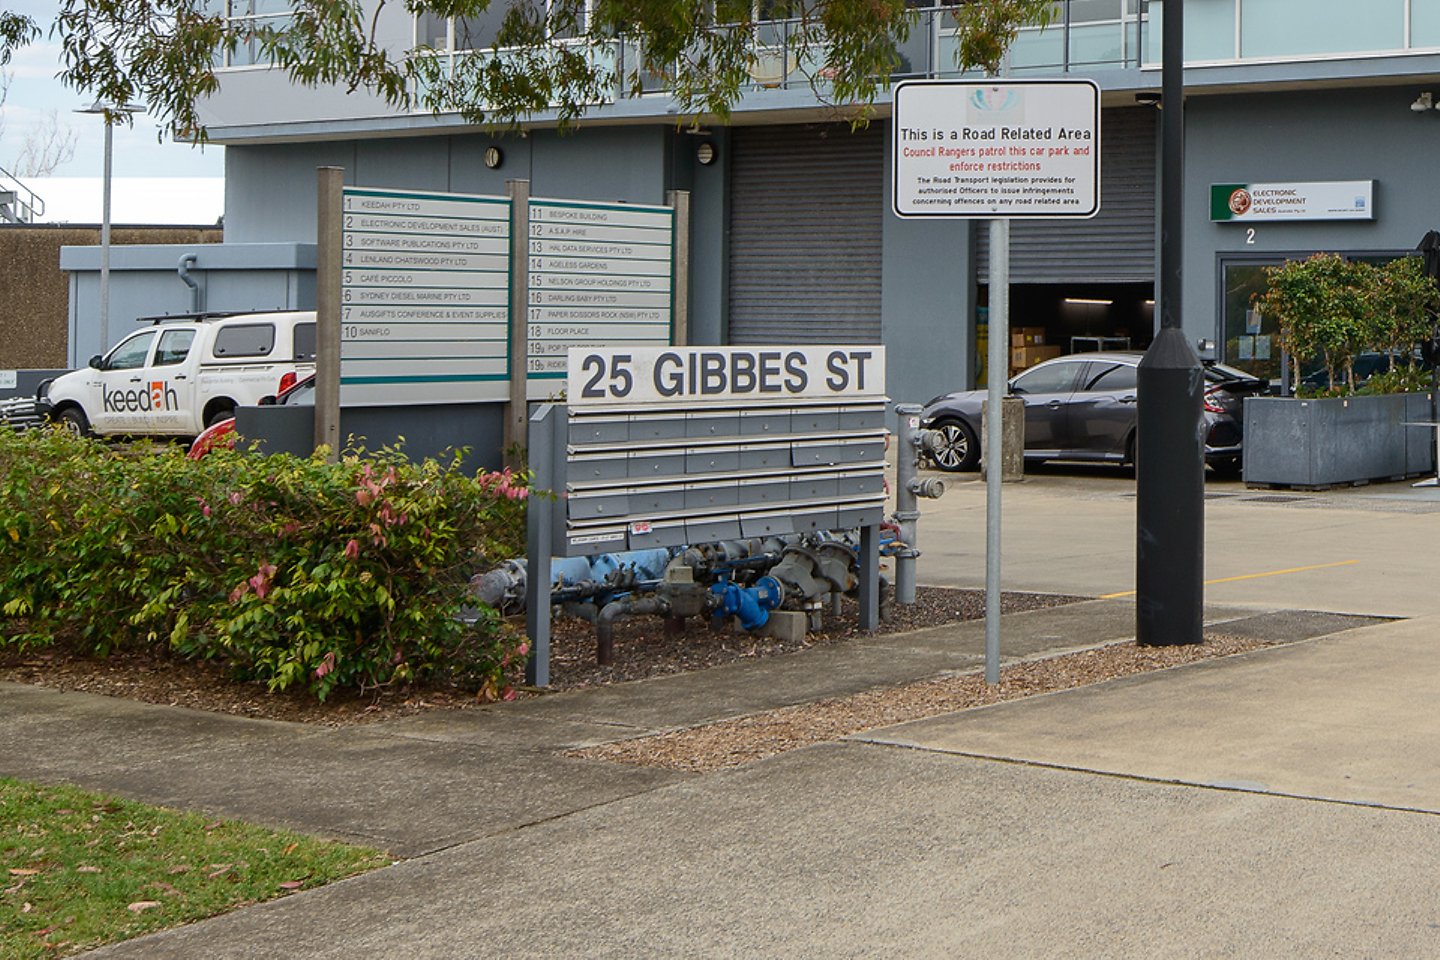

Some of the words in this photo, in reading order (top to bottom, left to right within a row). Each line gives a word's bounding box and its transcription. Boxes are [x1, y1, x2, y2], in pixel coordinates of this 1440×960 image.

[901, 128, 928, 141] This
[933, 128, 944, 141] is
[950, 130, 958, 140] a
[962, 128, 996, 140] Road
[1001, 127, 1052, 140] Related
[1058, 127, 1091, 140] Area
[903, 147, 935, 157] Council
[938, 146, 976, 159] Rangers
[978, 146, 1006, 158] patrol
[1009, 145, 1027, 156] this
[1030, 146, 1045, 156] car
[1048, 145, 1069, 157] park
[1073, 145, 1090, 156] and
[949, 161, 985, 171] enforce
[987, 161, 1041, 171] restrictions
[954, 176, 989, 185] Transport
[991, 176, 1029, 185] legislation
[1031, 176, 1062, 184] provides
[1023, 187, 1074, 196] infringements
[1253, 189, 1297, 197] ELECTRONIC
[347, 198, 352, 210] 1
[361, 201, 391, 209] KEEDAH
[407, 203, 420, 211] LTD
[912, 198, 952, 206] concerning
[1253, 198, 1307, 206] DEVELOPMENT
[532, 208, 542, 219] 11
[549, 211, 578, 219] BESPOKE
[579, 212, 608, 221] BUILDING
[346, 216, 353, 228] 2
[361, 219, 406, 229] ELECTRONIC
[407, 221, 459, 231] DEVELOPMENT
[459, 224, 480, 232] SALES
[532, 225, 543, 236] 12
[1247, 228, 1256, 244] 2
[346, 234, 353, 247] 3
[361, 238, 401, 248] SOFTWARE
[402, 239, 451, 249] PUBLICATIONS
[452, 241, 465, 249] PTY
[466, 241, 479, 250] LTD
[532, 242, 543, 253] 13
[578, 245, 608, 254] SERVICES
[609, 246, 620, 254] PTY
[621, 247, 632, 255] LTD
[346, 253, 353, 265] 4
[394, 256, 439, 265] CHATSWOOD
[440, 257, 453, 265] PTY
[455, 258, 468, 266] LTD
[531, 258, 542, 269] 14
[549, 261, 578, 269] AGELESS
[578, 262, 608, 270] GARDENS
[345, 271, 352, 284] 5
[381, 275, 413, 283] PICCOLO
[531, 275, 542, 287] 15
[548, 278, 573, 286] NELSON
[574, 278, 596, 286] GROUP
[597, 279, 627, 287] HOLDINGS
[628, 279, 640, 287] PTY
[344, 289, 352, 302] 6
[360, 292, 390, 300] SYDNEY
[391, 292, 415, 300] DIESEL
[416, 293, 443, 301] MARINE
[444, 293, 457, 301] PTY
[458, 293, 471, 301] LTD
[531, 292, 542, 303] 16
[548, 294, 574, 302] DARLING
[576, 295, 592, 303] BABY
[593, 295, 605, 303] PTY
[344, 308, 352, 320] 7
[397, 311, 444, 319] CONFERENCE
[446, 311, 451, 319] &
[452, 311, 474, 319] EVENT
[475, 311, 506, 320] SUPPLIES
[531, 309, 542, 320] 17
[570, 311, 600, 319] SCISSORS
[344, 326, 358, 338] 10
[359, 328, 390, 336] SANIFLO
[531, 326, 542, 337] 18
[581, 353, 634, 399] 25
[653, 351, 809, 397] GIBBES
[825, 351, 872, 392] ST
[103, 381, 179, 413] keedah
